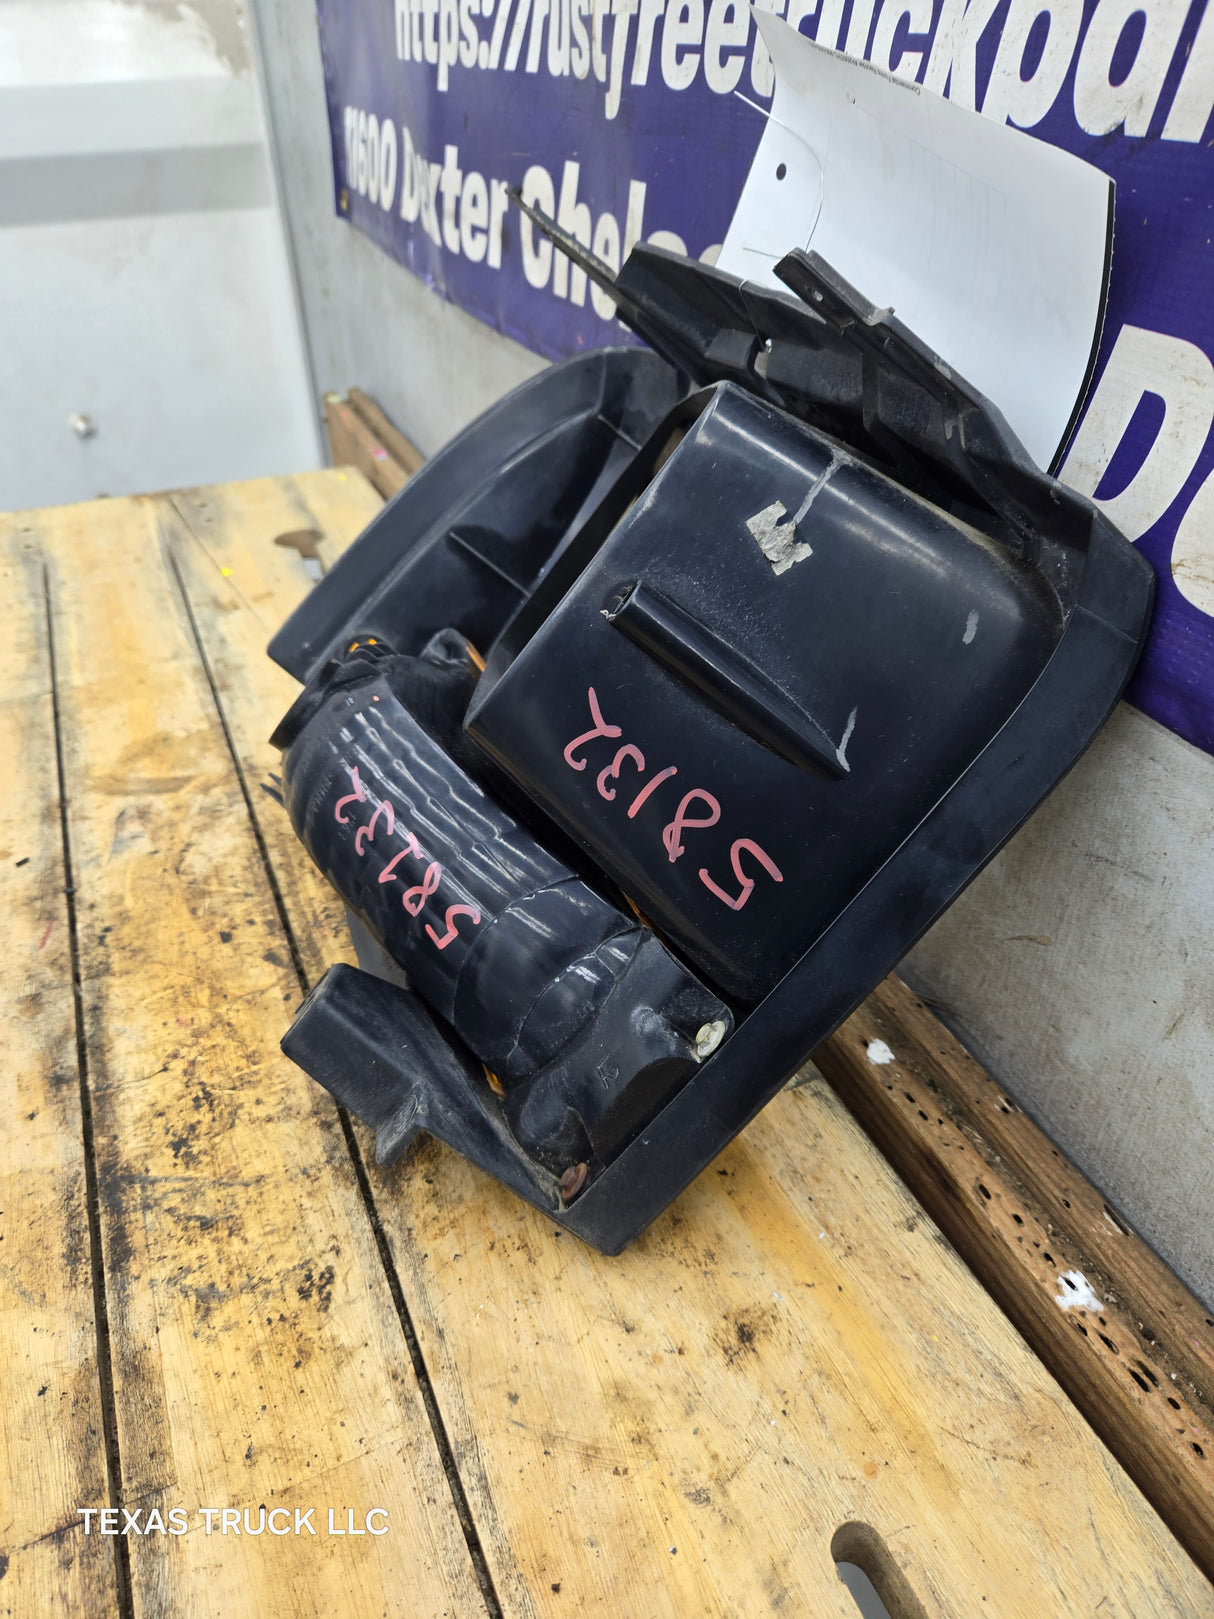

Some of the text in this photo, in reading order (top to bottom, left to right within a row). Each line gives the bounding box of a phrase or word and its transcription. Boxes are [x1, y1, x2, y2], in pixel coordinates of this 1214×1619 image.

[520, 160, 723, 332] Chel
[335, 766, 481, 950] 58132
[563, 686, 784, 910] 58132
